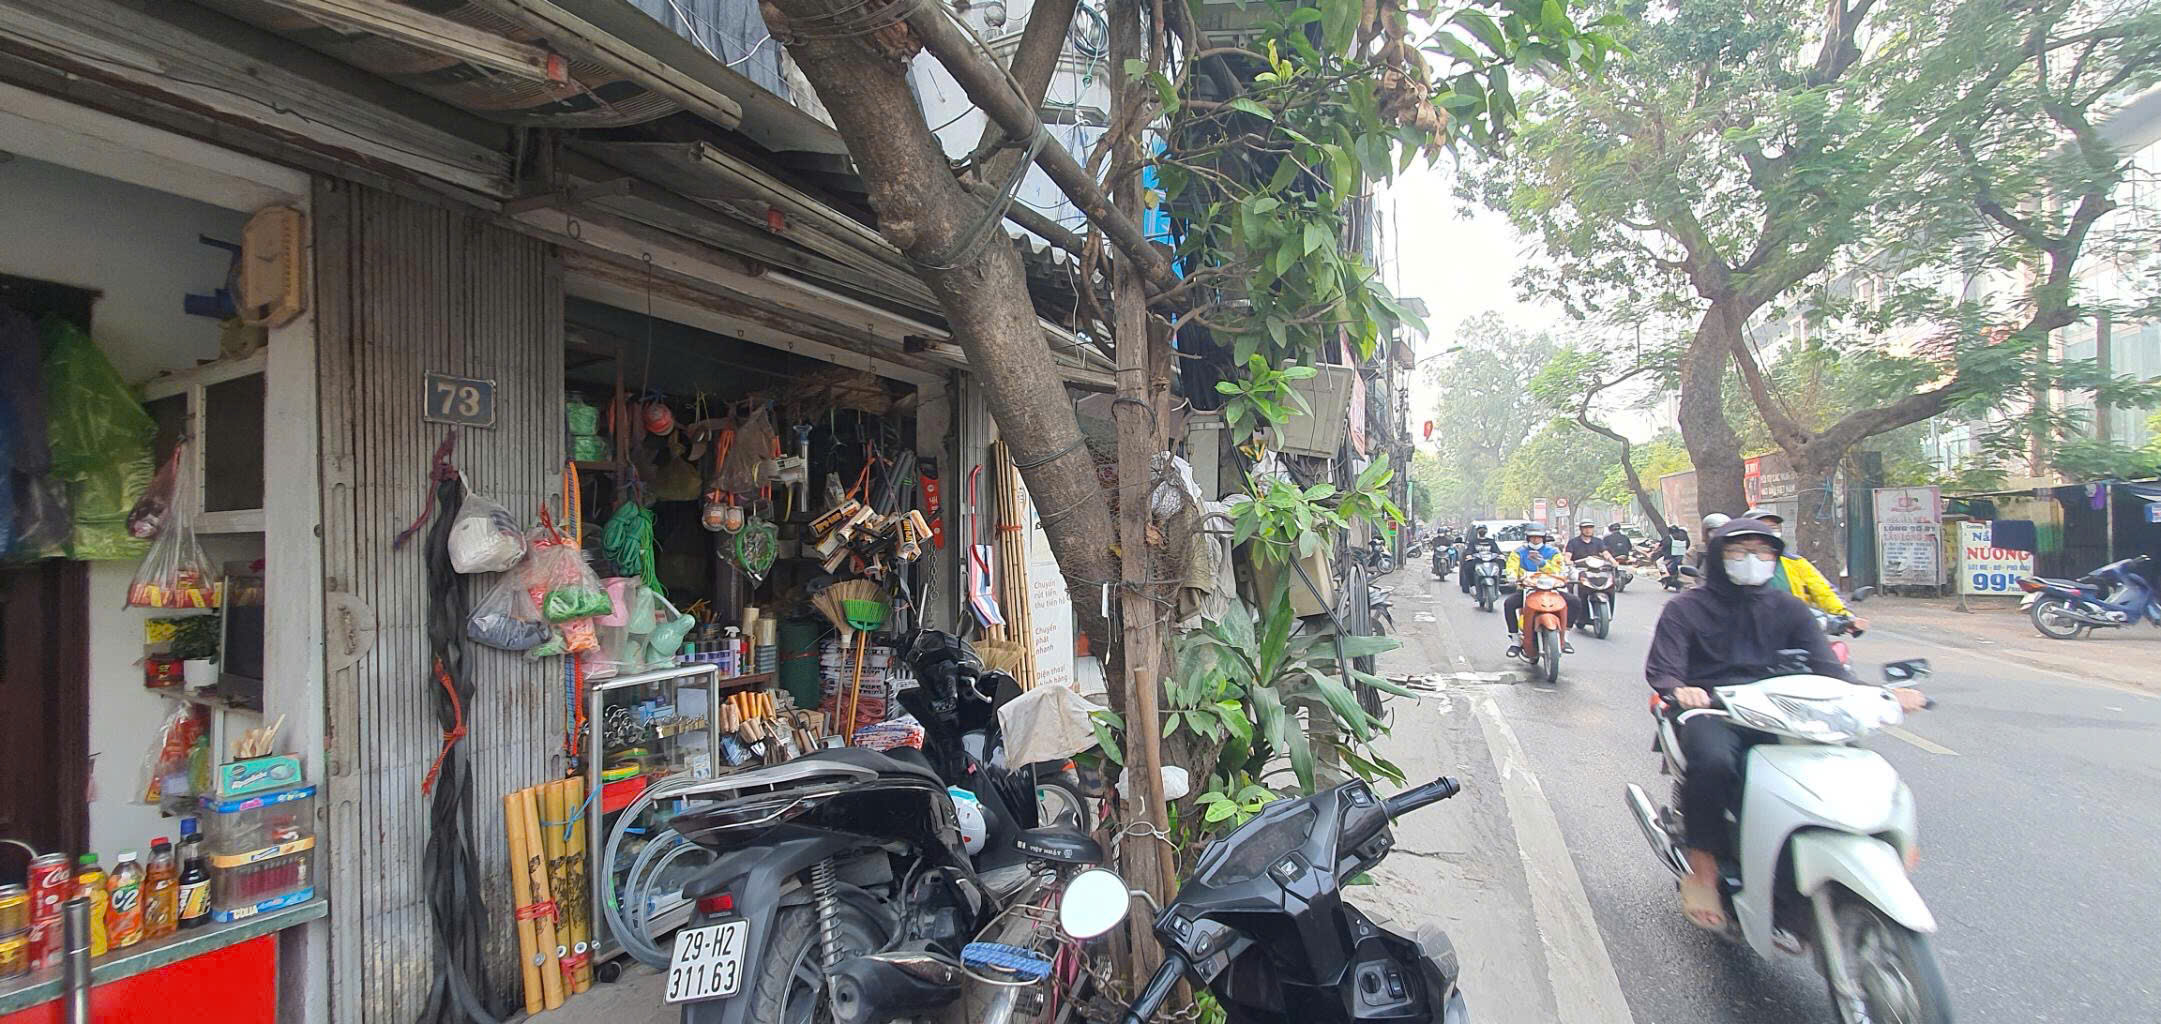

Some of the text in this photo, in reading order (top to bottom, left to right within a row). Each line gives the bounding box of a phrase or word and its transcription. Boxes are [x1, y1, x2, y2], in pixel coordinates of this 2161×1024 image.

[437, 382, 481, 417] 73
[111, 889, 139, 911] C2
[681, 925, 735, 963] 29-H2
[670, 959, 737, 999] 311.63
